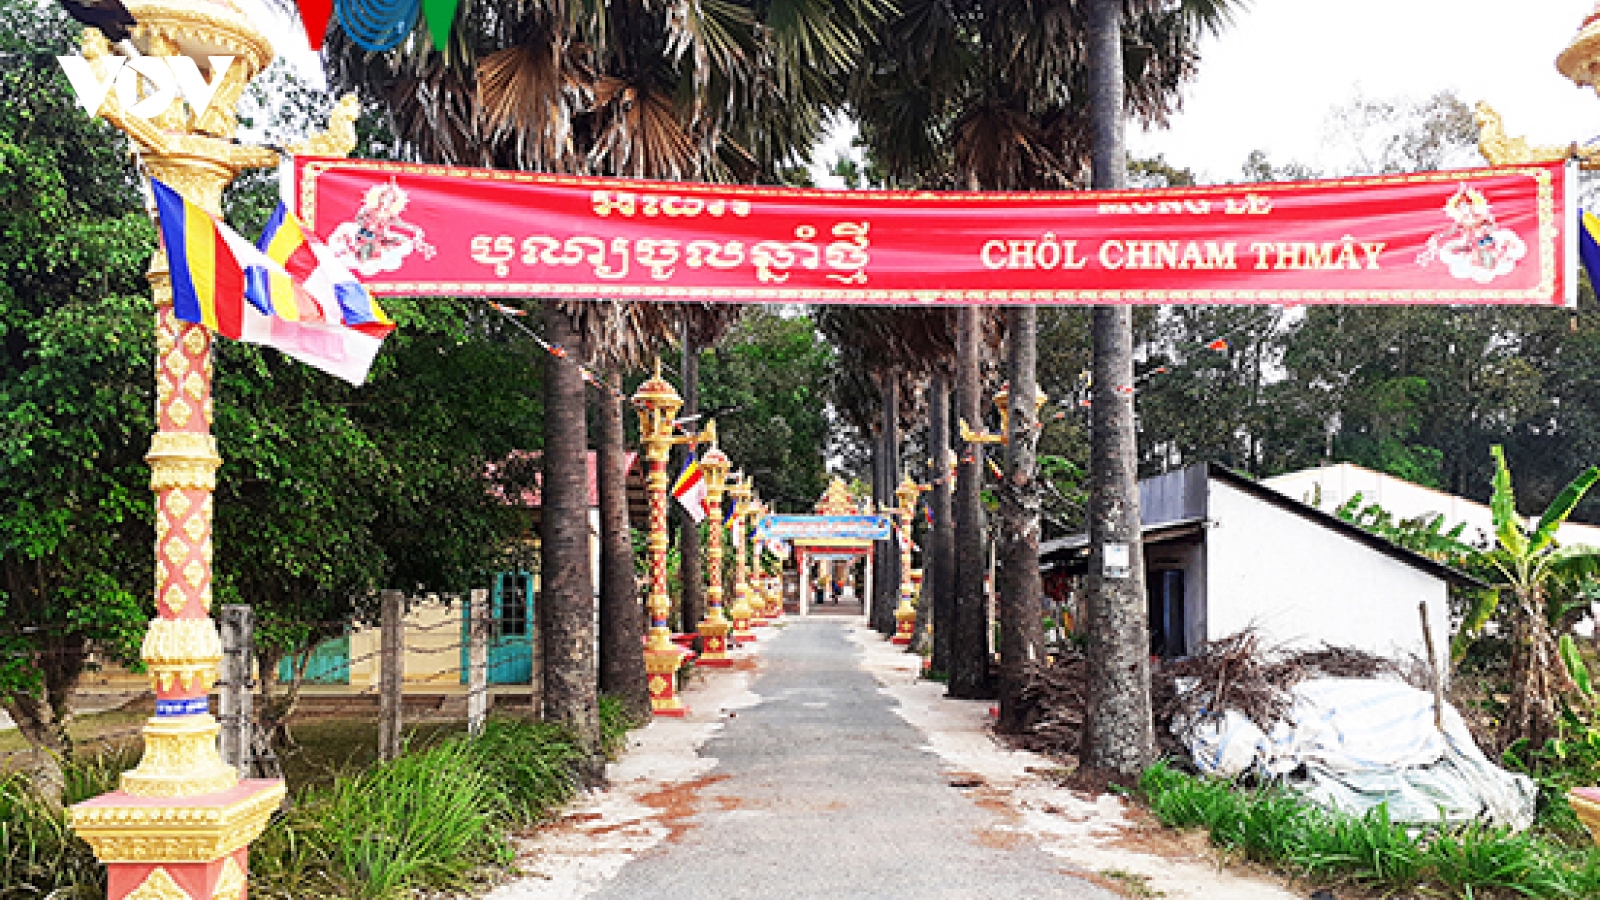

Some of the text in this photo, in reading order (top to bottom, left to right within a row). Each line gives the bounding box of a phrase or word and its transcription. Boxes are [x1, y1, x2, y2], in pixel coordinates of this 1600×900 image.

[980, 232, 1386, 270] CHÔL CHNAM THMÂY
